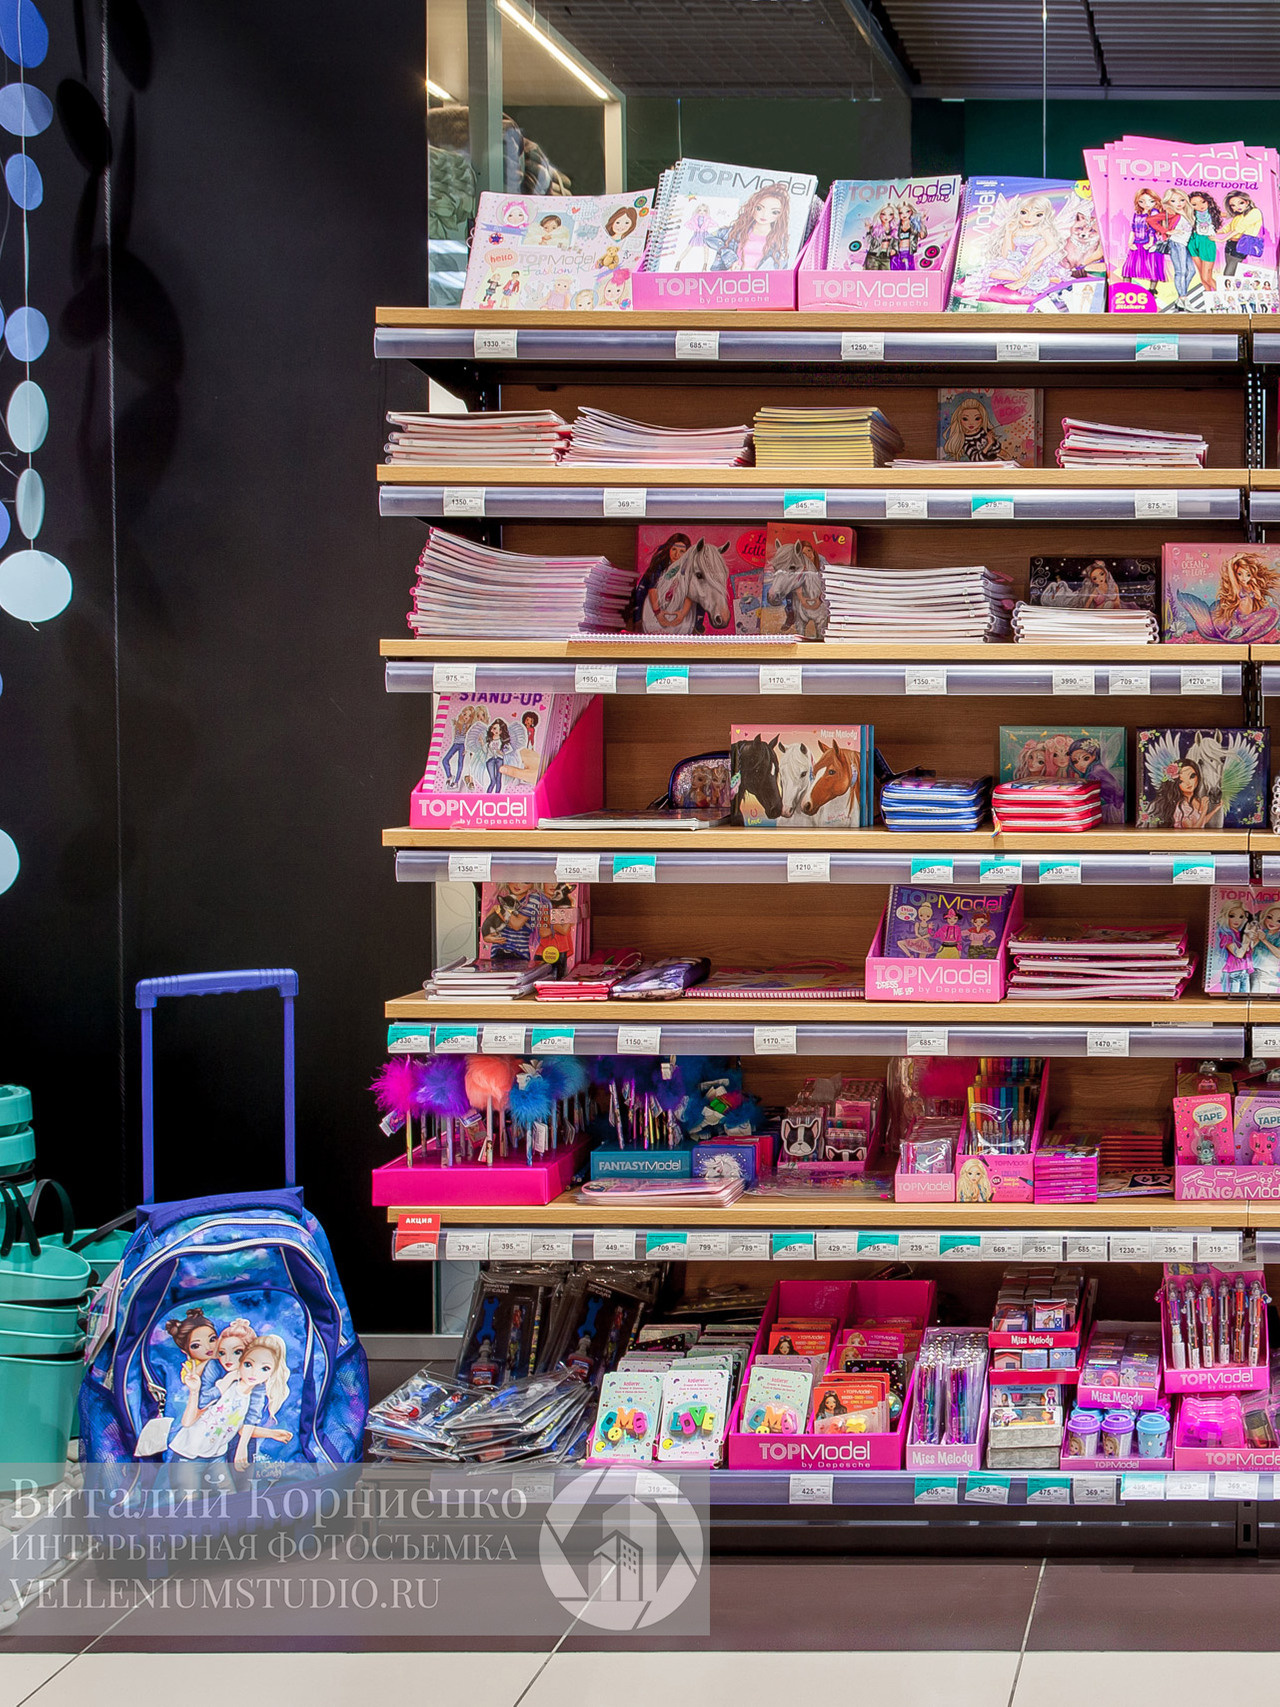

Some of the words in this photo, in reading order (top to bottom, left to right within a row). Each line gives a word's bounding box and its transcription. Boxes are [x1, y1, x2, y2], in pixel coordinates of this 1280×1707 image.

[1116, 157, 1263, 182] TOPModel
[686, 165, 813, 197] TOPModel
[1174, 178, 1259, 192] Stickerworld
[848, 183, 956, 202] TOPModel
[655, 273, 769, 296] TOPModel
[812, 281, 929, 298] TOPModel
[717, 295, 769, 303] Depesche
[873, 299, 928, 308] Depesche
[1115, 292, 1148, 305] 206
[460, 692, 544, 706] STAND-UP
[418, 797, 527, 817] TOPModel
[475, 816, 527, 825] Depesche
[900, 888, 1003, 912] TOPModel
[873, 964, 992, 986] TOPModel
[918, 986, 929, 995] by
[936, 986, 992, 994] Depesche
[1197, 1112, 1223, 1122] TAPE
[598, 1159, 682, 1171] FANTASYModel
[898, 1181, 952, 1192] TOPModel
[405, 1217, 432, 1225] АКЦИЯ
[1011, 1335, 1028, 1345] Miss
[1030, 1334, 1054, 1346] Melody
[1180, 1369, 1253, 1387] TOPModel
[1091, 1389, 1110, 1401] Miss
[1112, 1389, 1144, 1406] Melody
[670, 1405, 716, 1433] LOVE
[759, 1440, 871, 1462] TOPModel
[913, 1450, 940, 1463] Miss
[943, 1449, 974, 1467] Melody
